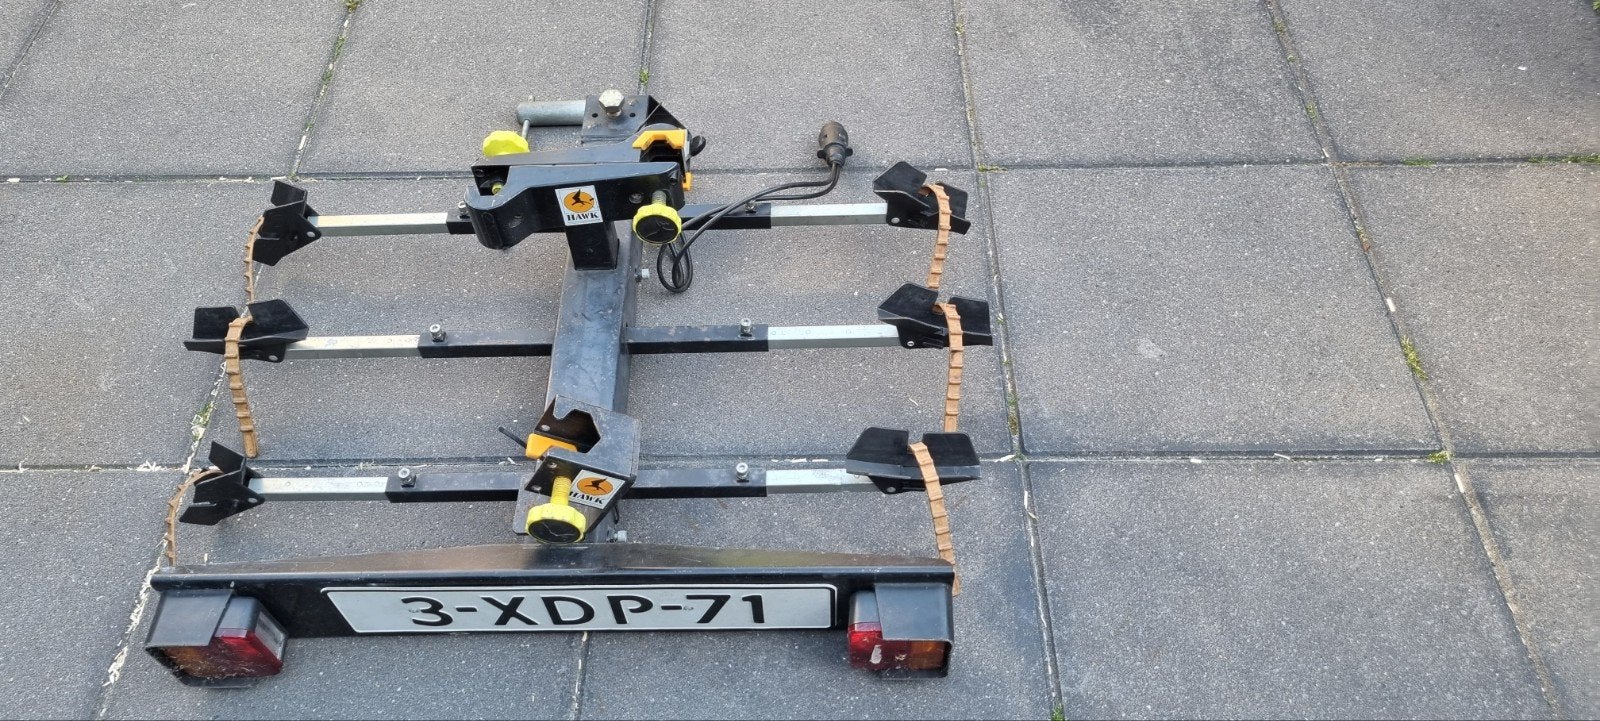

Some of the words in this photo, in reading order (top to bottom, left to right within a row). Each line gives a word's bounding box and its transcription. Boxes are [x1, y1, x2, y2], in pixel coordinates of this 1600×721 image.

[567, 212, 599, 221] HAWK
[569, 491, 604, 504] HAWK
[401, 594, 765, 627] 3-XDP-71
